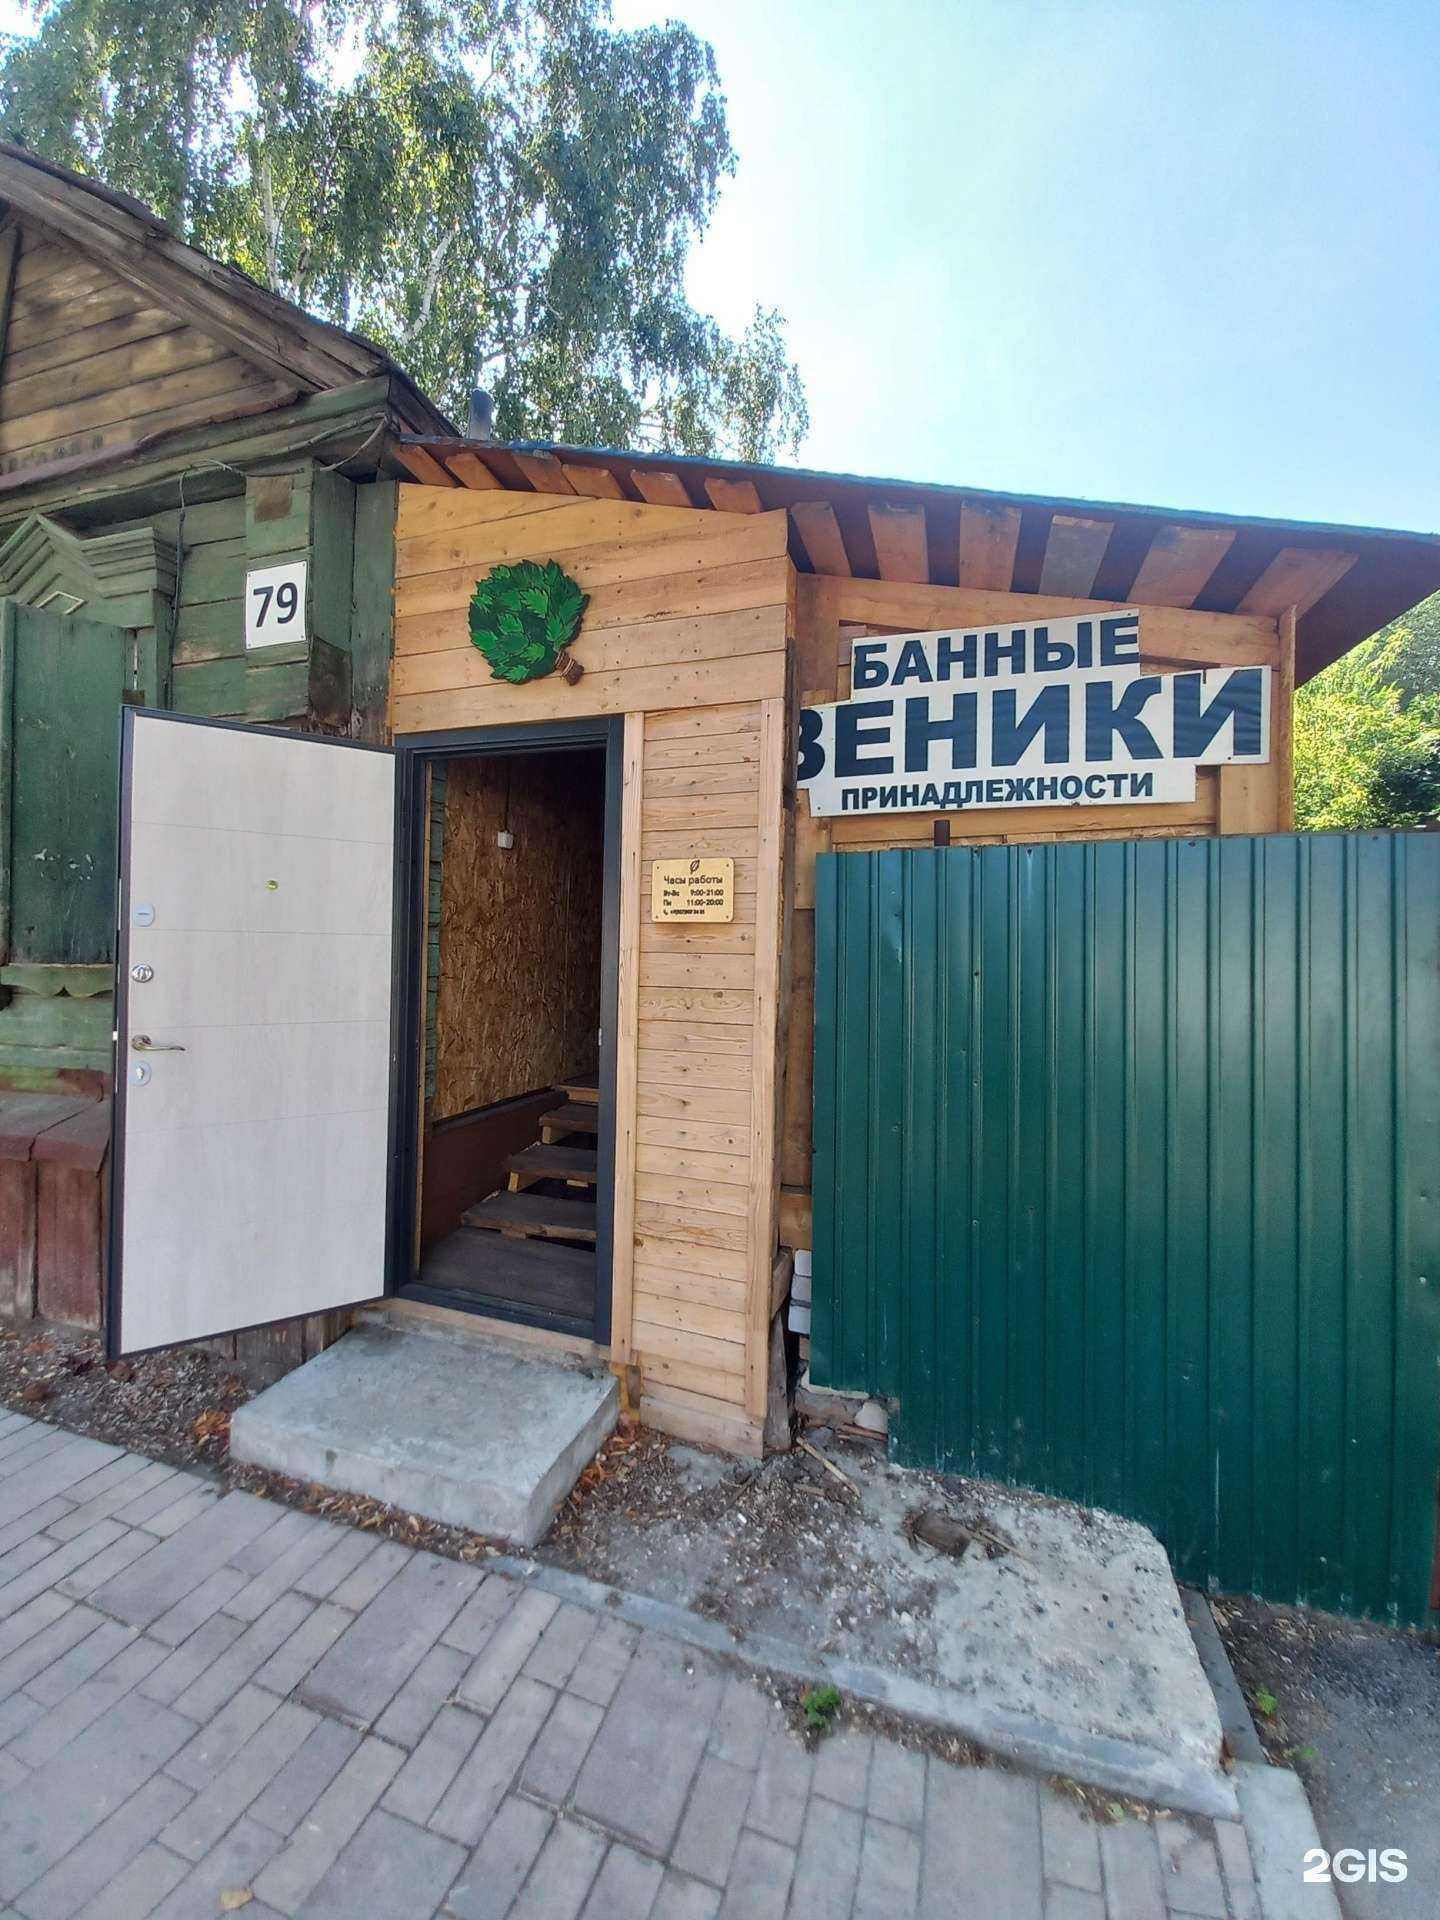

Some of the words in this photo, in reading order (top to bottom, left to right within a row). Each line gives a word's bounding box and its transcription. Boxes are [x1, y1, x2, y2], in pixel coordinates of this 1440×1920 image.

[253, 582, 298, 628] 79
[854, 615, 1140, 690] БАННЫЕ
[841, 772, 1153, 811] ПРИНАДЛЕЖНОСТИ
[663, 875, 686, 884] Часы
[688, 874, 723, 886] работы
